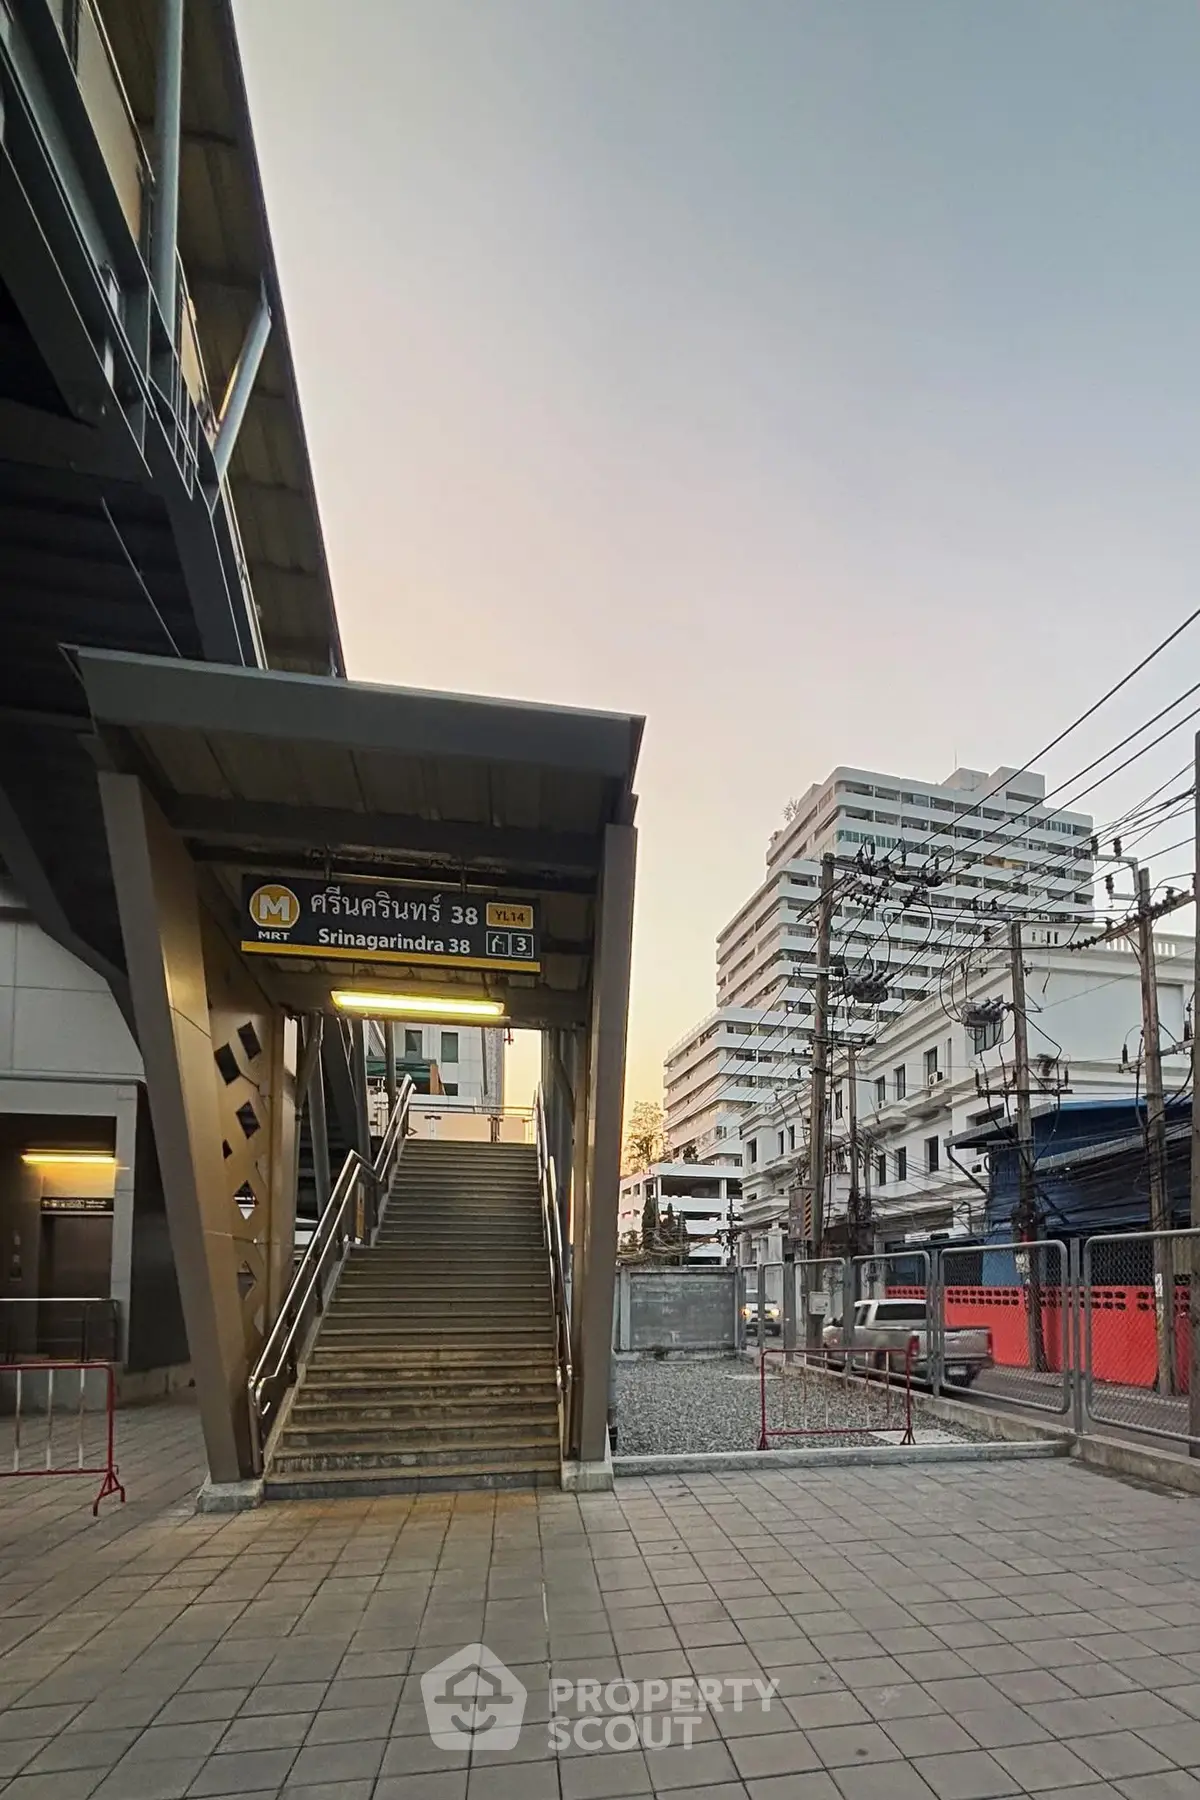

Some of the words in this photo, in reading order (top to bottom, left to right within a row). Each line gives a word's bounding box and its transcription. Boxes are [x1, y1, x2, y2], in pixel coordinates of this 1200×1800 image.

[259, 893, 290, 921] M
[311, 885, 442, 923] ศรีนครินทร์
[451, 905, 479, 926] 38
[495, 910, 525, 923] YL14
[257, 930, 291, 941] MRT
[318, 927, 445, 953] Srinagarindra
[448, 938, 471, 954] 38
[516, 936, 527, 952] 3
